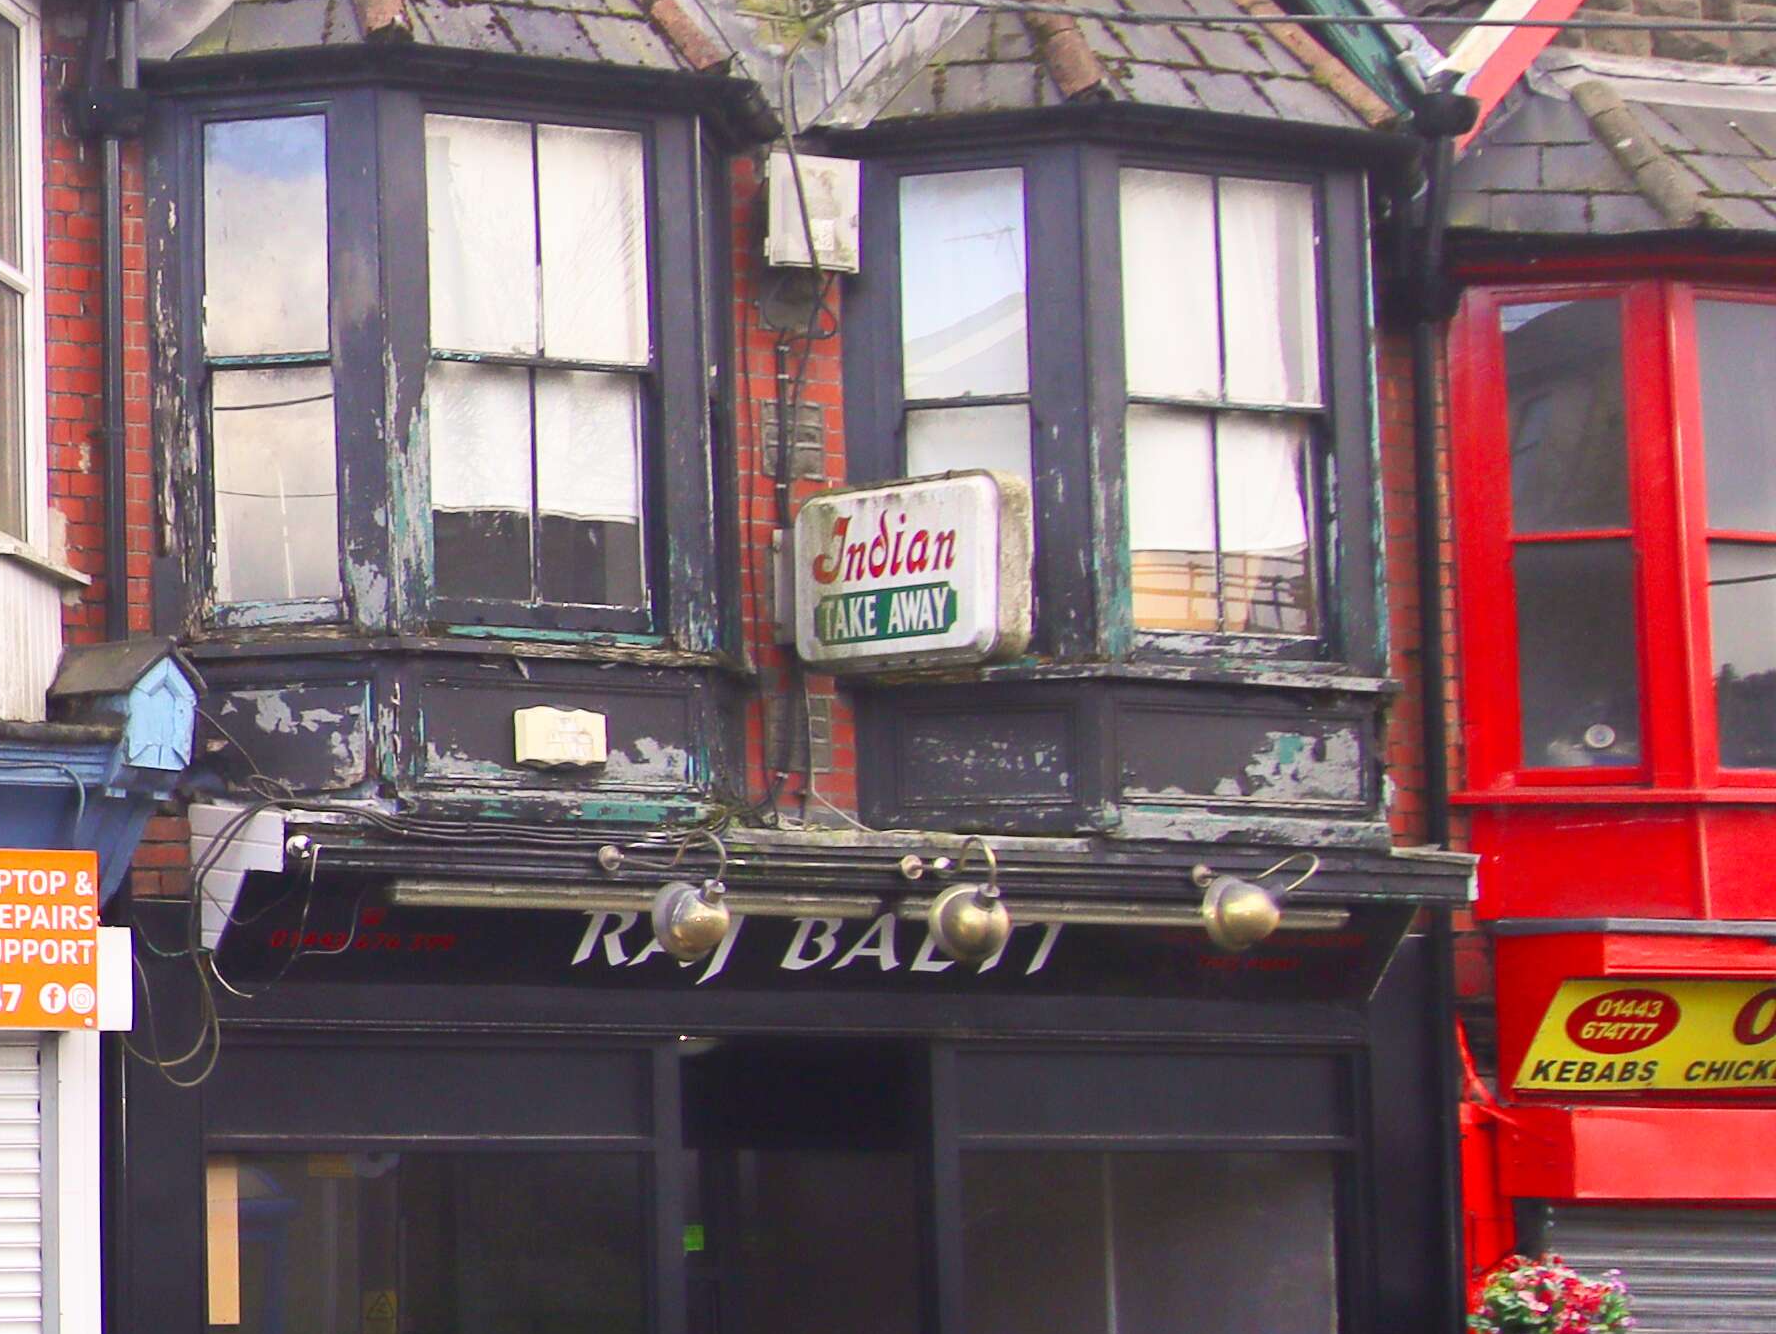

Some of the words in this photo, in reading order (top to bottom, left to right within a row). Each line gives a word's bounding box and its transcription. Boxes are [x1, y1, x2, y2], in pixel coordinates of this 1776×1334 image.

[813, 508, 956, 584] Indian
[822, 594, 878, 642] TAKE
[887, 586, 949, 633] AWAY
[74, 871, 94, 896] &
[572, 908, 745, 985] RJ
[1596, 999, 1664, 1017] 01443
[1580, 1021, 1659, 1041] 674777
[1530, 1060, 1659, 1084] KEBABS
